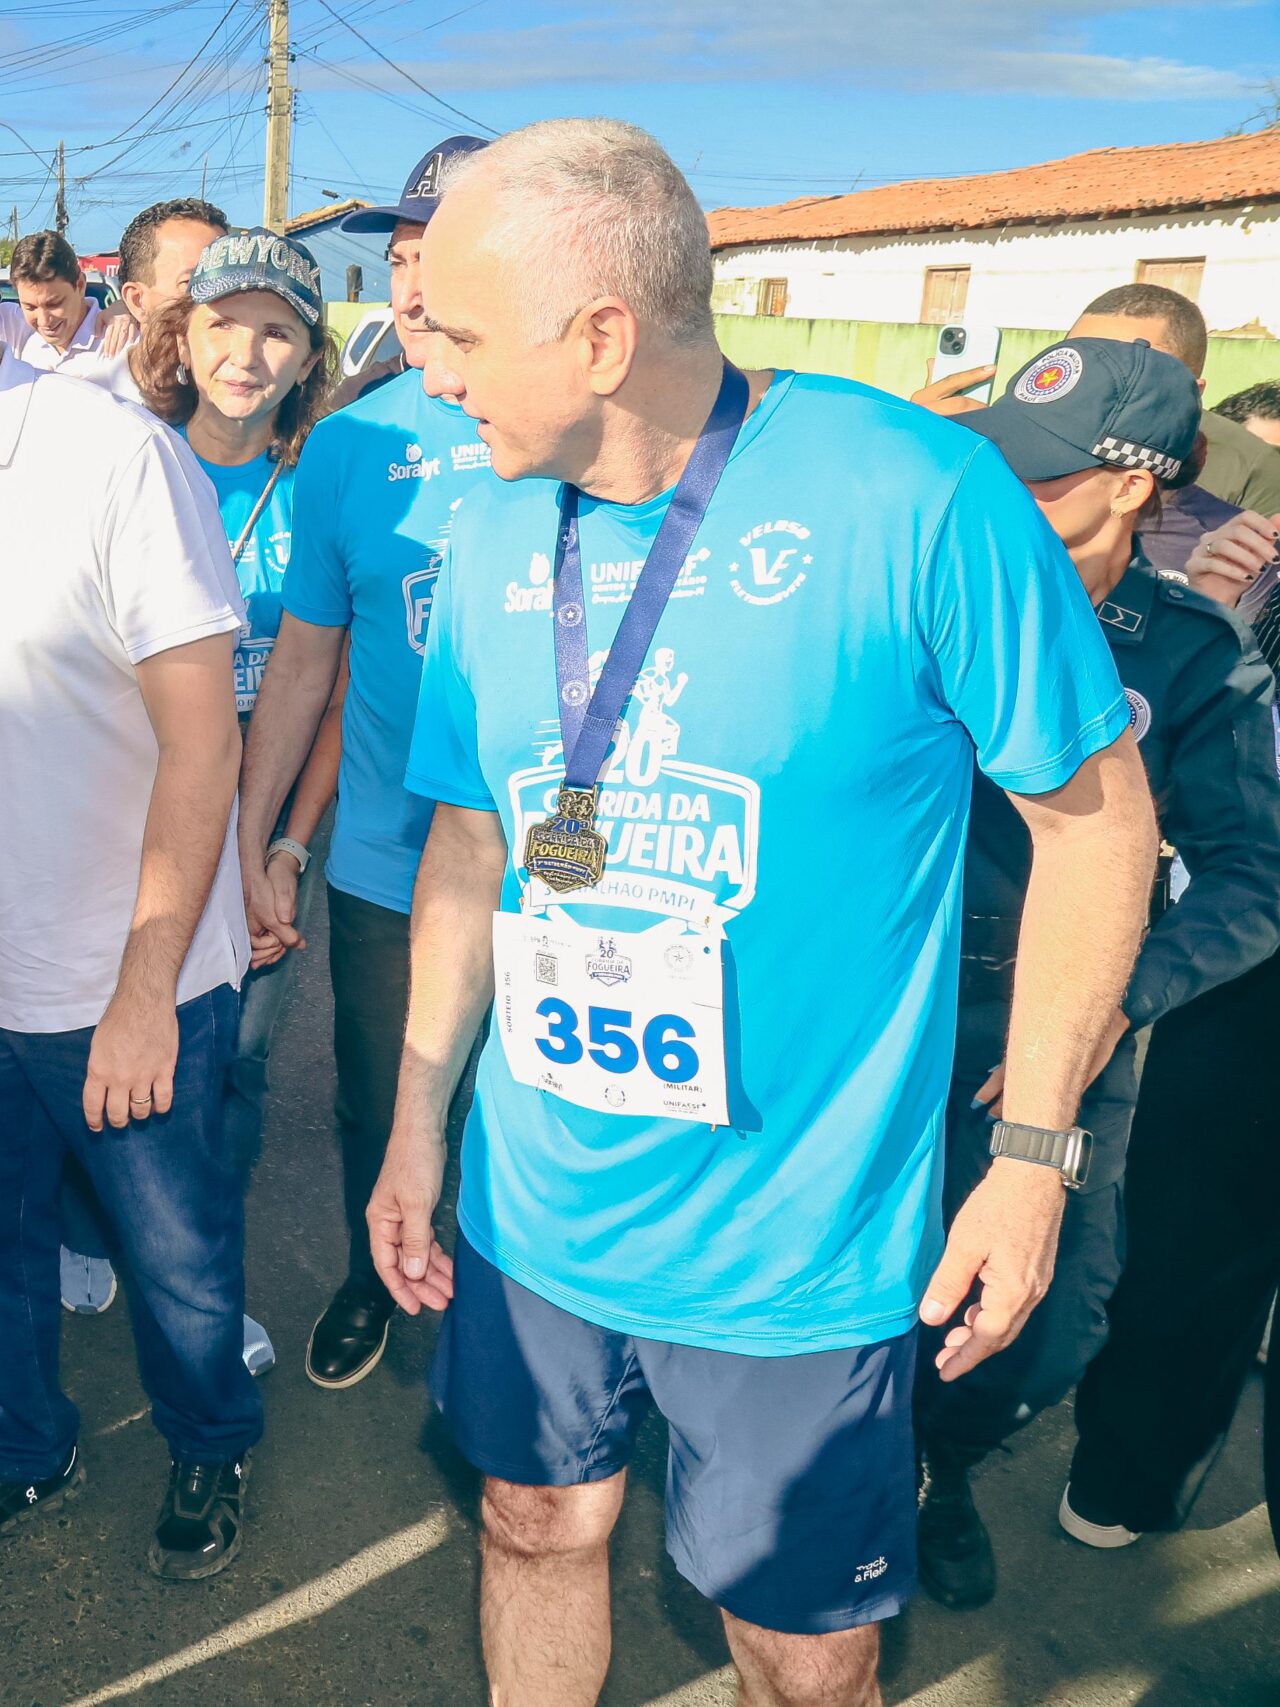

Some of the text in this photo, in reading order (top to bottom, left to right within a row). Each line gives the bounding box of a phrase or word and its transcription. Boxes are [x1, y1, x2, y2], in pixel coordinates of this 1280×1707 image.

[405, 152, 442, 198] A
[387, 458, 440, 481] Soralyt
[667, 793, 711, 822] DA
[529, 842, 598, 866] FOGUEIRA
[647, 887, 697, 912] PMPI
[600, 949, 615, 959] 20
[587, 961, 631, 976] FOGUEIRA
[534, 996, 700, 1084] 356
